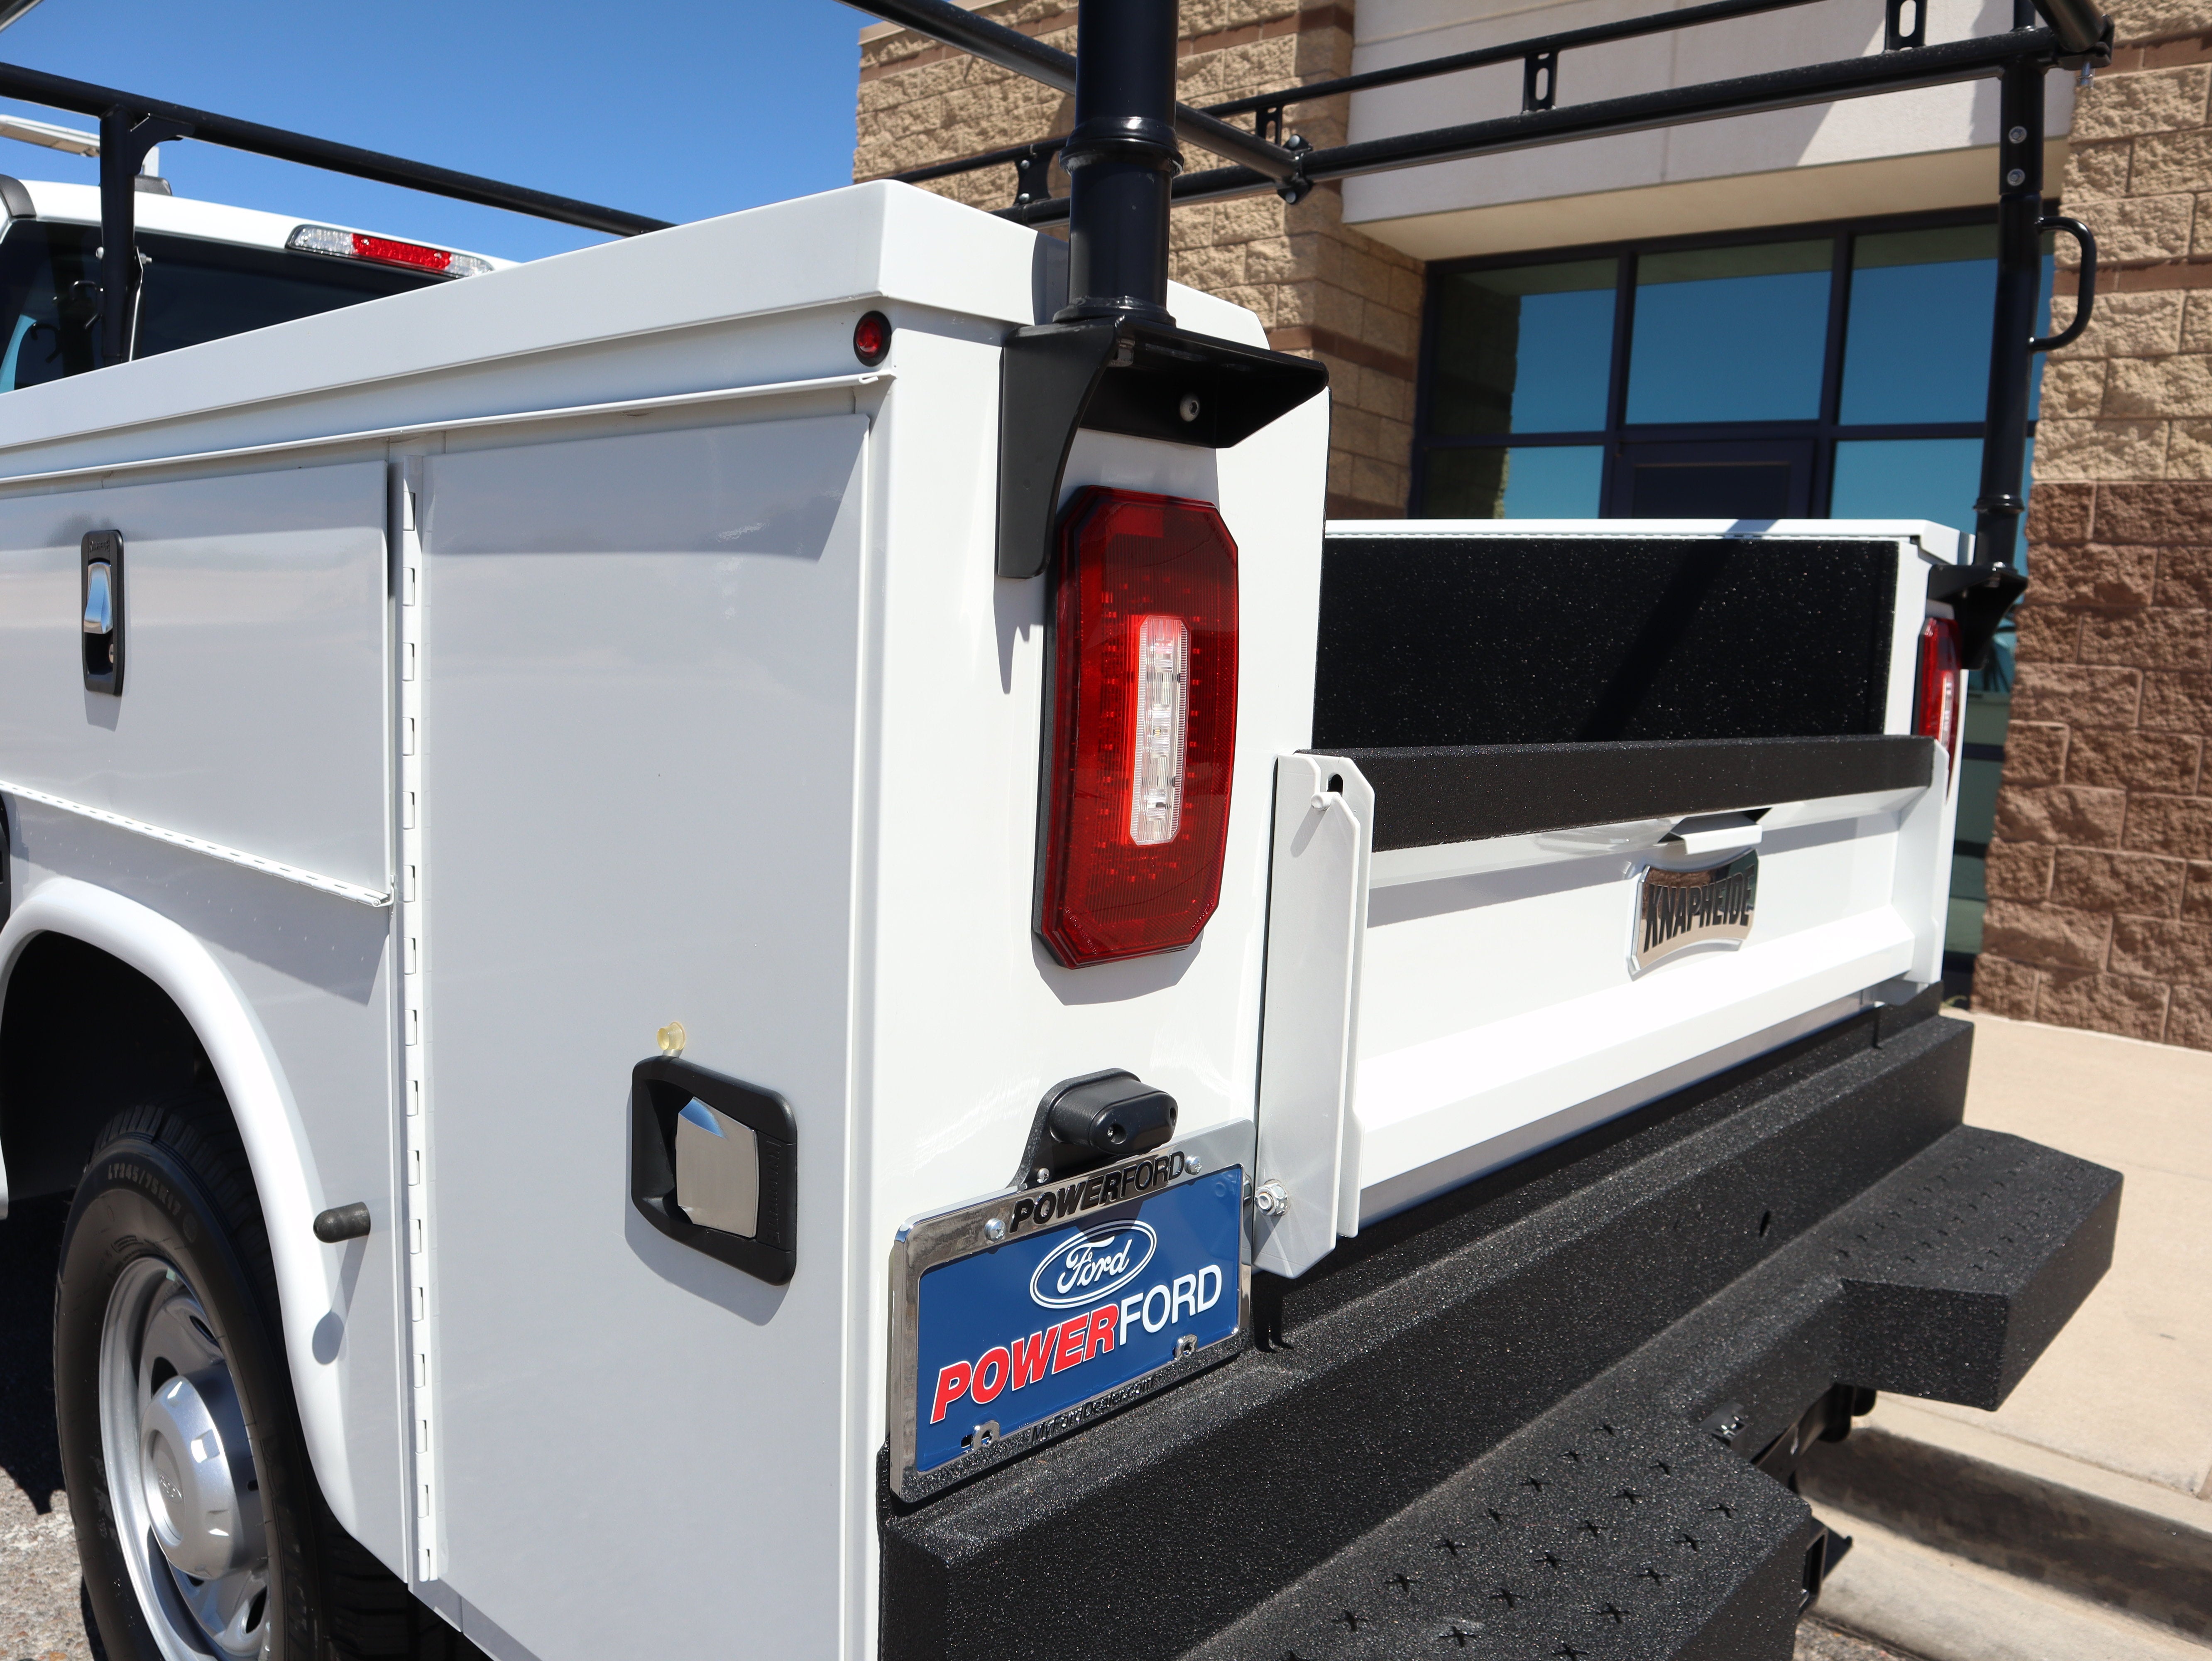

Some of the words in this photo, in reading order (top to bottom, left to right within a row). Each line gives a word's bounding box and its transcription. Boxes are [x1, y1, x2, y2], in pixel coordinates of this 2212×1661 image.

[1644, 865, 1755, 953] KNAPHEIDE
[1009, 1151, 1185, 1233] POWERFORD
[1057, 1235, 1133, 1294] Ford
[930, 1264, 1222, 1424] POWERFORD
[1028, 1377, 1153, 1443] MyFordDealer.com
